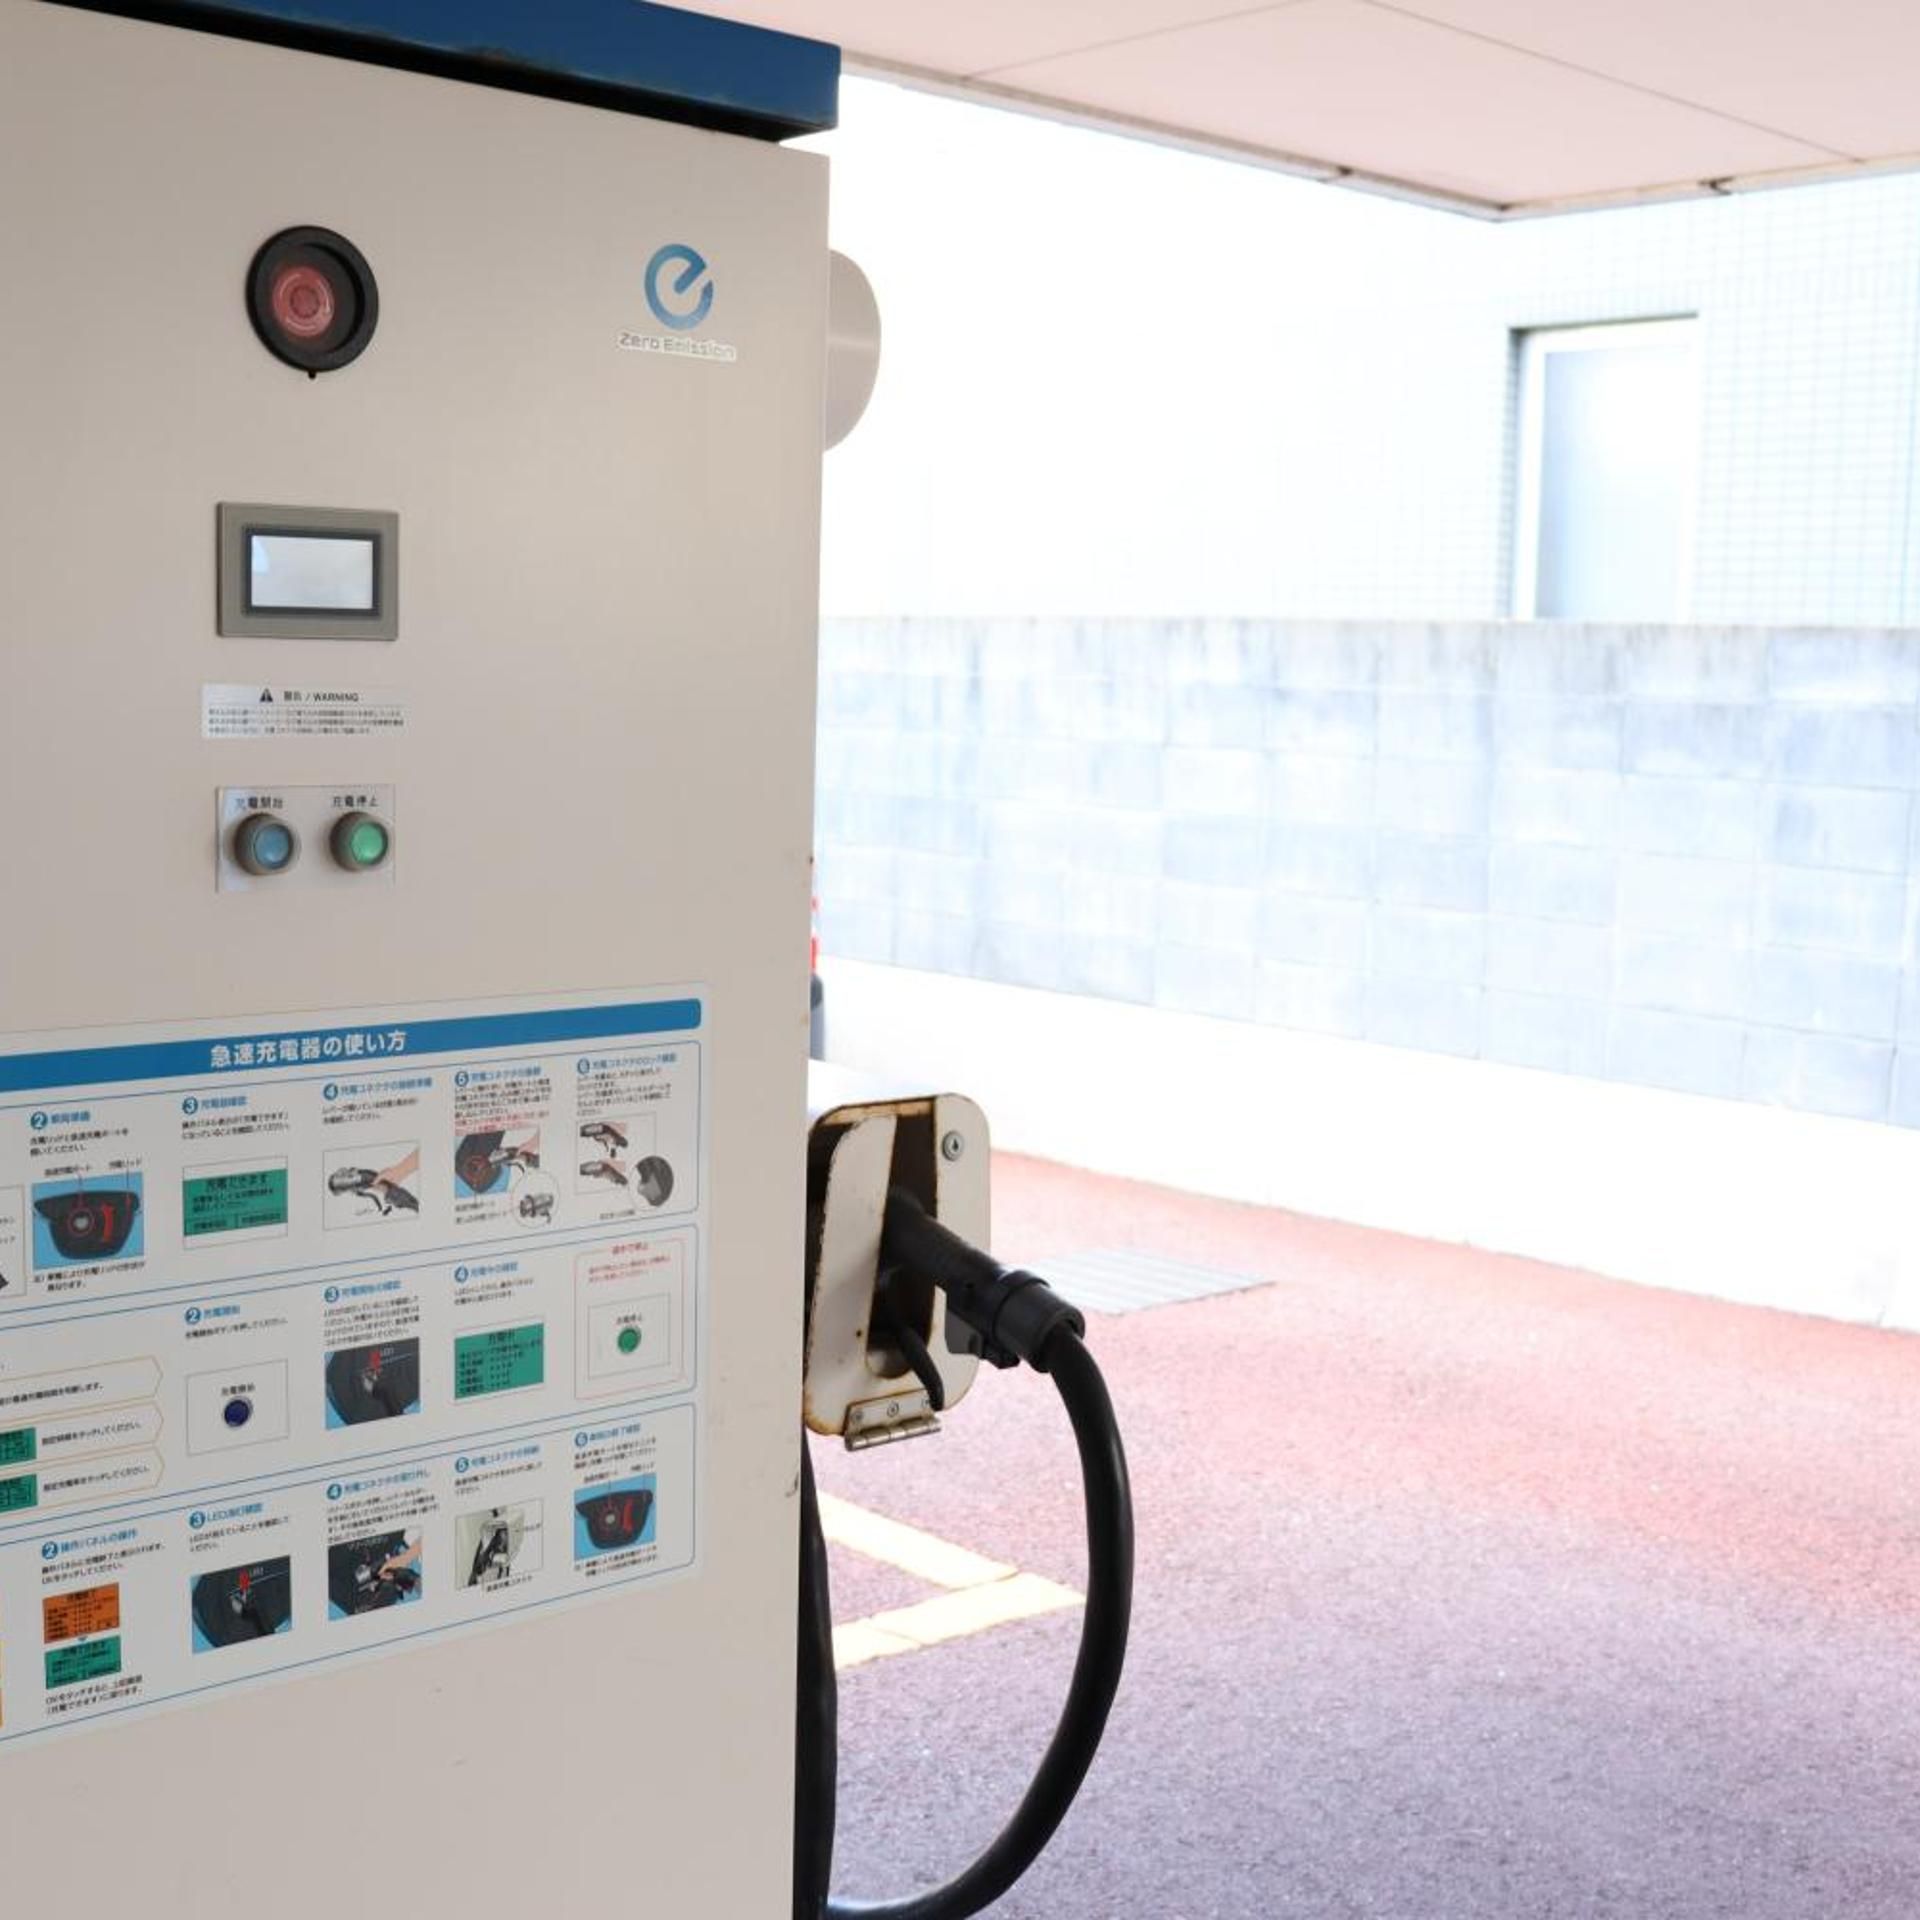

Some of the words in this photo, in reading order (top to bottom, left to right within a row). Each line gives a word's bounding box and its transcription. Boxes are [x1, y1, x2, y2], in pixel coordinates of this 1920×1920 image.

[313, 691, 360, 703] WARNING
[333, 794, 379, 807] 充電停止
[210, 1029, 407, 1068] 急速充電器の使い方
